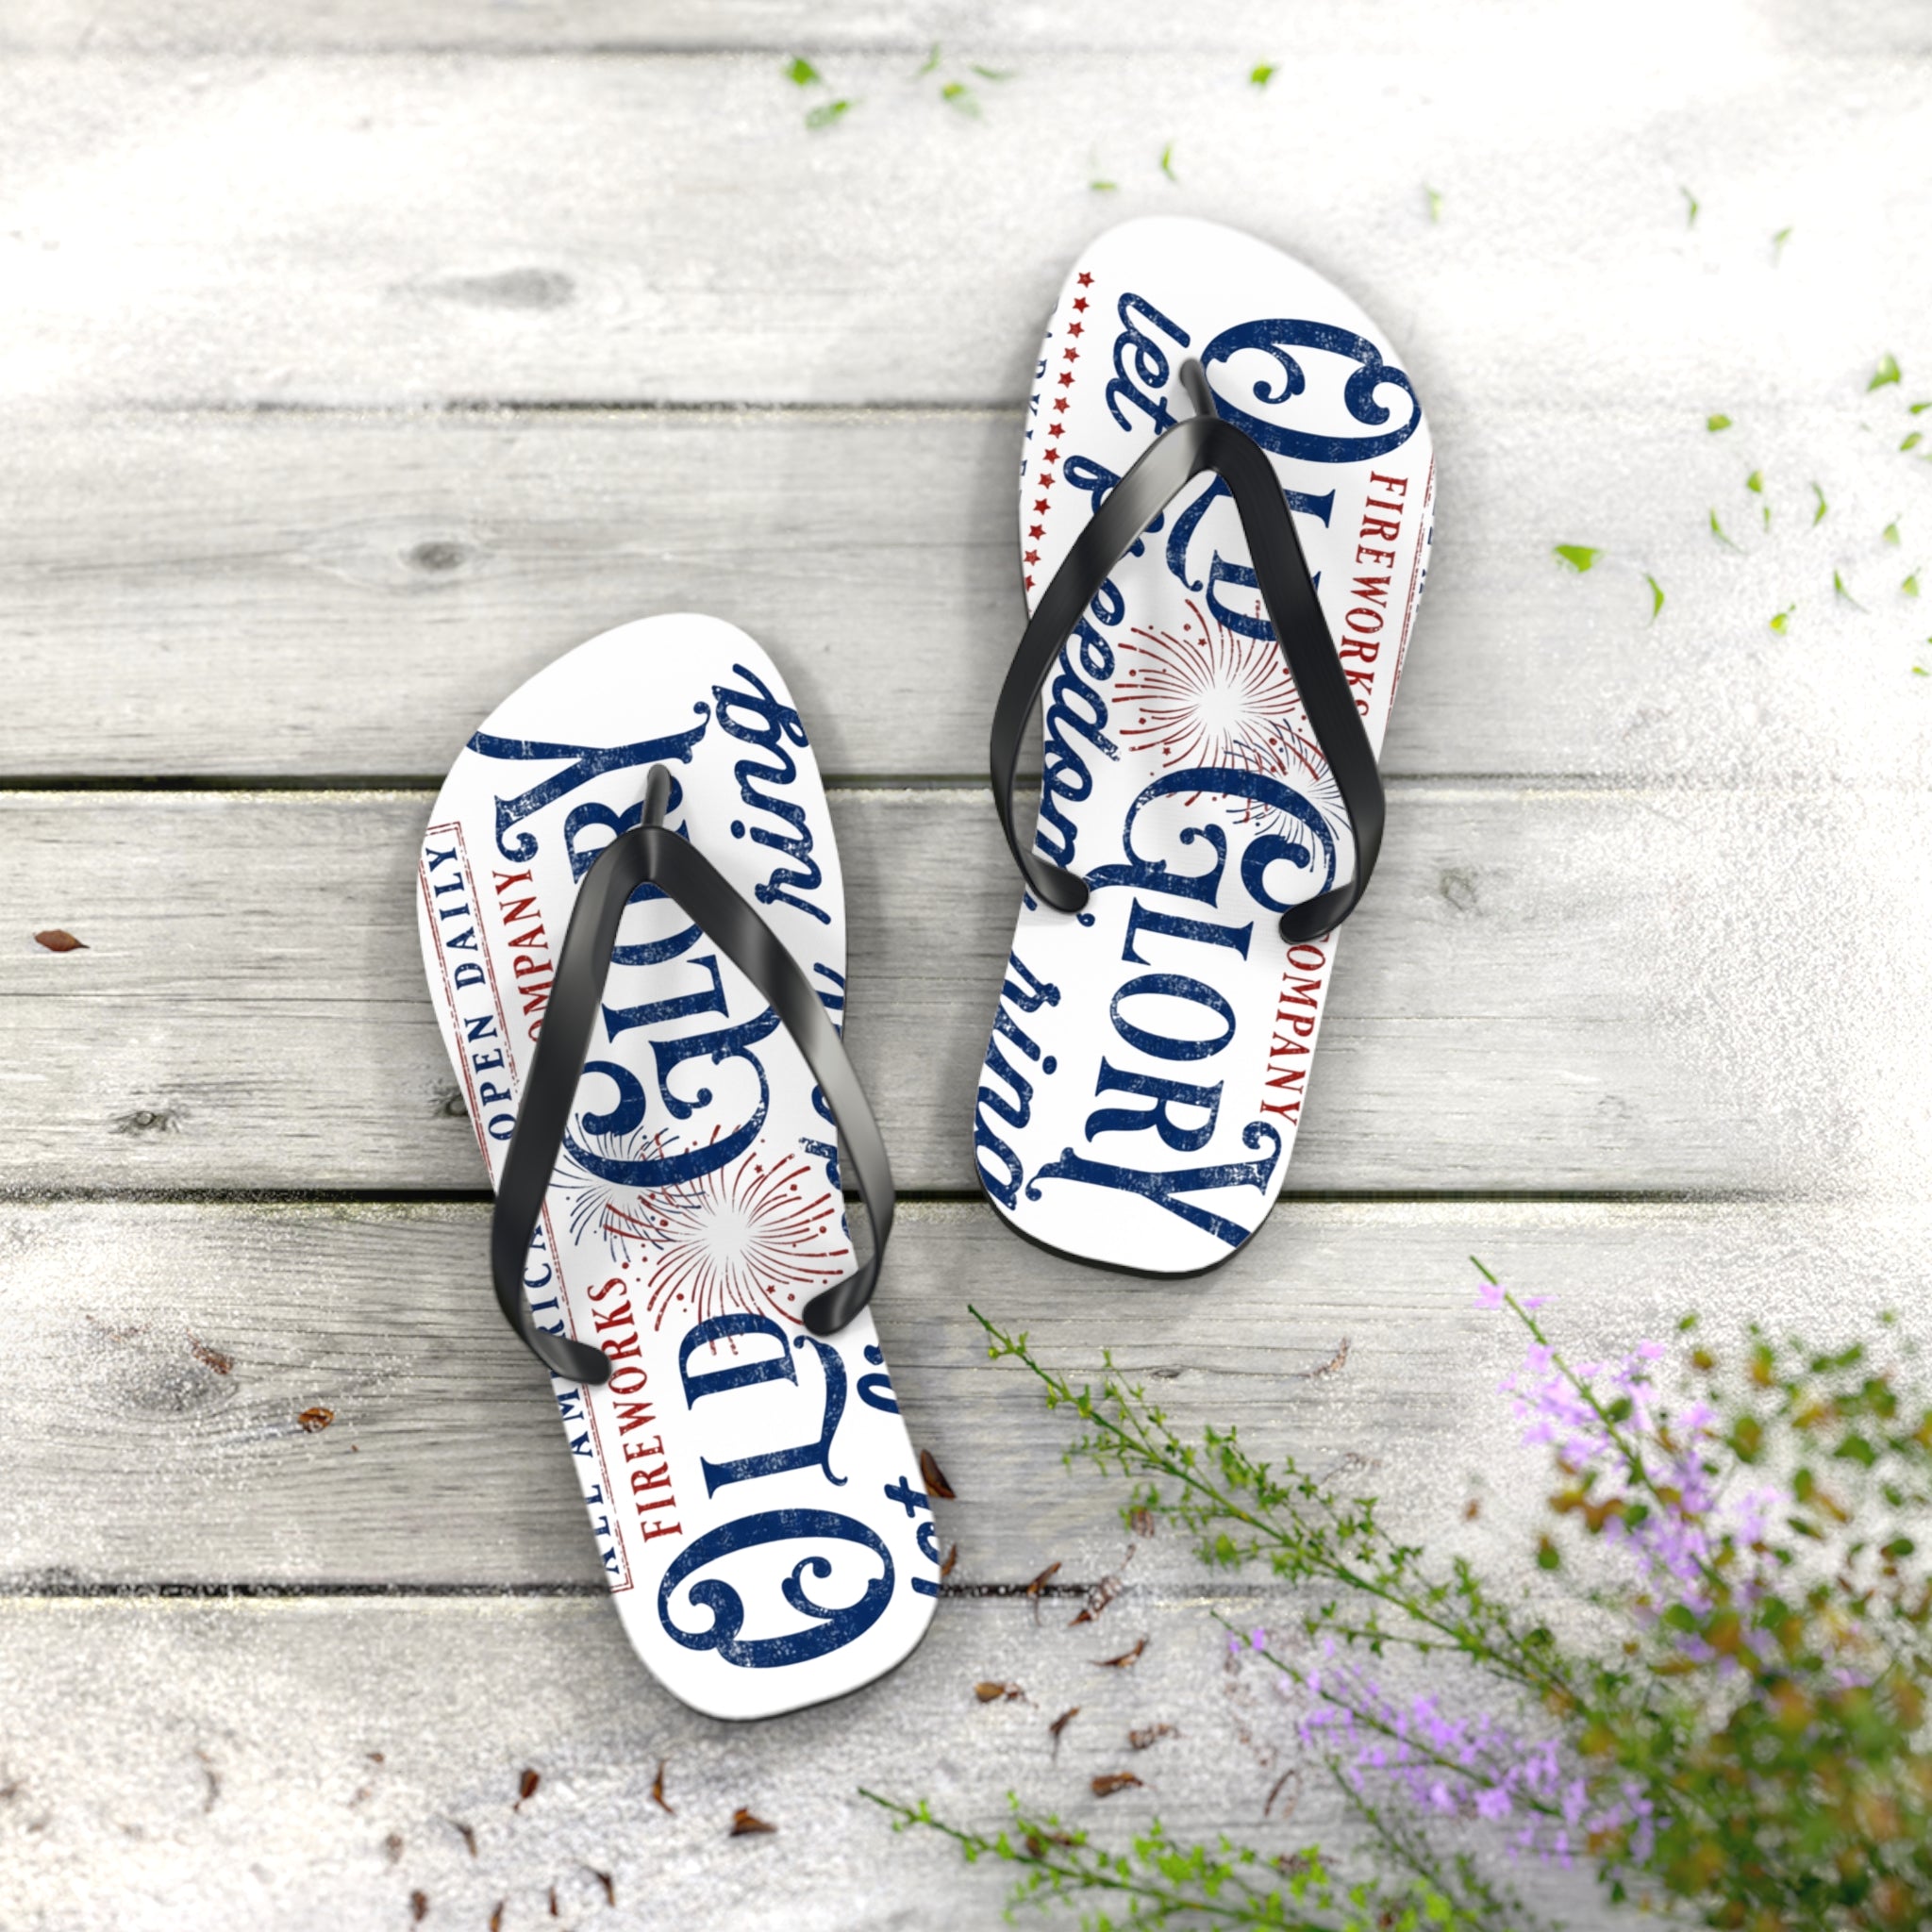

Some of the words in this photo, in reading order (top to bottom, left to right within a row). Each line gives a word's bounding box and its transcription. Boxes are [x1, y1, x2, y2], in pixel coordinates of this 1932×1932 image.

[425, 845, 487, 991] DAILY
[711, 663, 832, 924] ring
[464, 1014, 518, 1142] OPEN
[1025, 767, 1337, 1248] GLORY
[1260, 932, 1330, 1126] OMPANY
[587, 1276, 684, 1543] FIREWORKS
[658, 1313, 895, 1668] OLD
